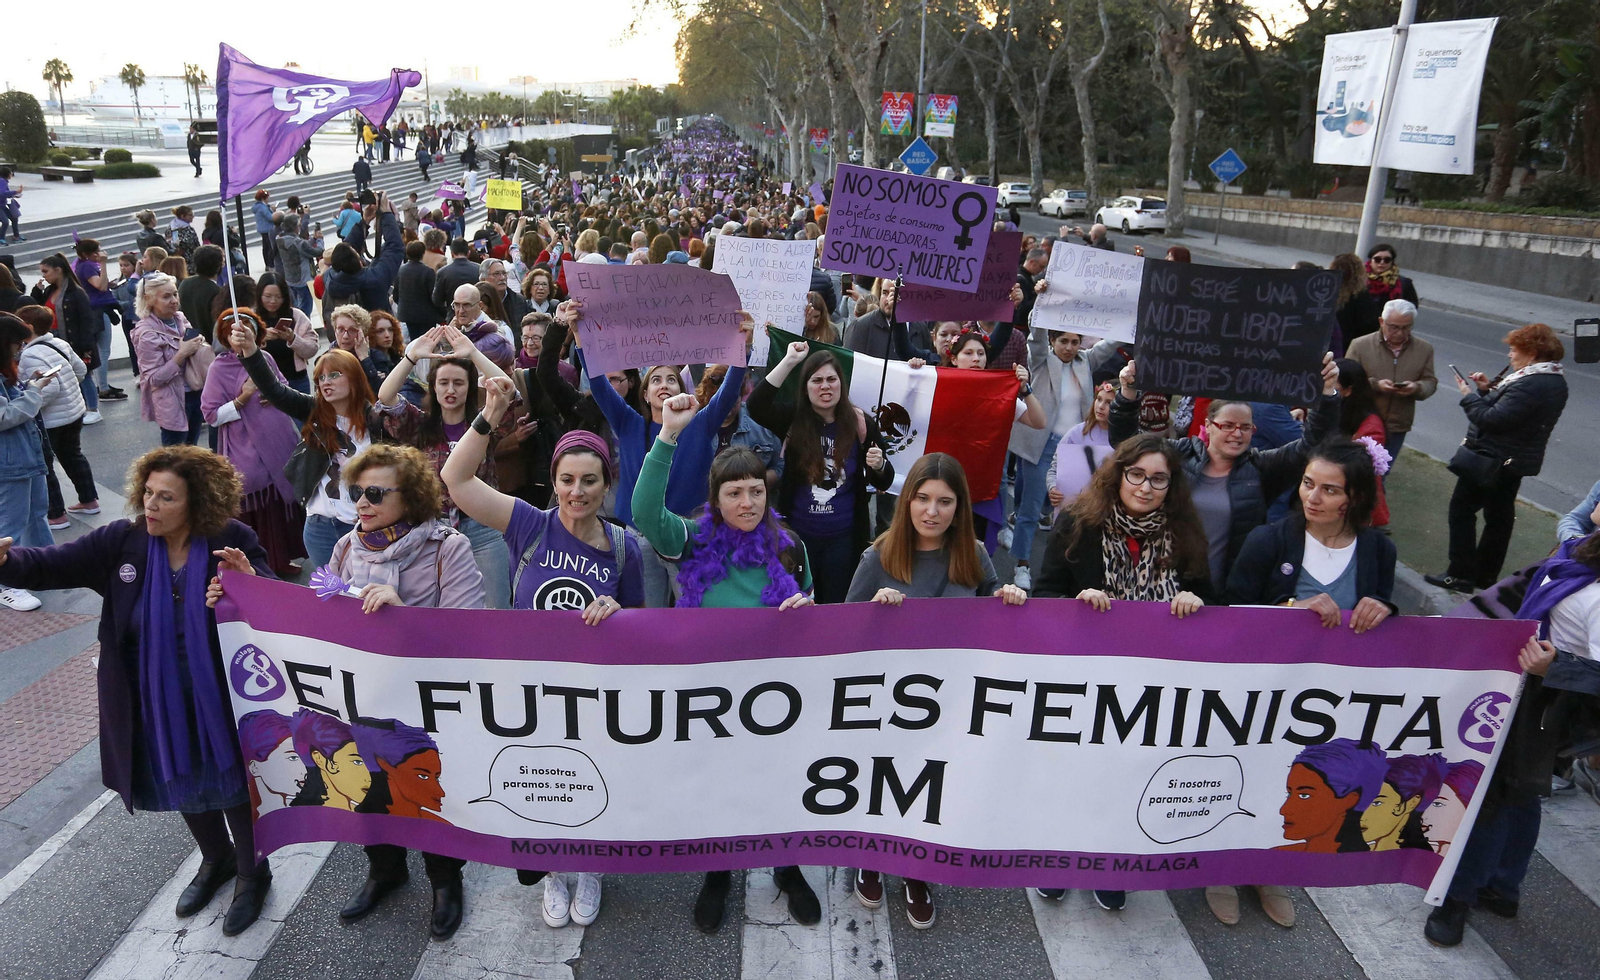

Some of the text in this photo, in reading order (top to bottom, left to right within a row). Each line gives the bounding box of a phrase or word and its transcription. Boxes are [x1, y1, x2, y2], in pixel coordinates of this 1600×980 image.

[1425, 49, 1462, 58] queremos
[1402, 123, 1428, 134] hay que
[842, 171, 950, 209] NO SOMOS
[836, 201, 945, 232] objetos de consumo
[720, 238, 813, 257] EXIGIMOS ALTO
[831, 224, 938, 253] ni INCUBADORAS,
[718, 253, 807, 270] A LA VIOLENCIA
[826, 241, 978, 285] SOMOS MUJERES
[736, 270, 754, 280] LA
[761, 270, 806, 282] MUJER
[1083, 279, 1098, 295] X
[1150, 267, 1298, 307] NO SERÉ UNA
[600, 301, 629, 314] UNA
[636, 293, 694, 310] FORMA
[701, 291, 720, 308] DE
[625, 312, 740, 330] INDIVIDUALMENTE
[1143, 300, 1303, 347] MUJER LIBRE
[586, 340, 593, 355] Y
[598, 338, 615, 353] DE
[1140, 333, 1283, 362] MIENTRAS HAYA
[1139, 355, 1317, 403] MUJERES OPRIMIDAS
[539, 549, 611, 584] JUNTAS
[282, 659, 396, 731] EL
[415, 681, 803, 745] FUTURO
[828, 672, 945, 731] ES
[967, 675, 1445, 751] FEMINISTA
[1480, 712, 1501, 730] marzo
[519, 765, 577, 778] Si nosotras
[569, 783, 594, 791] para
[801, 756, 949, 827] 8M
[1167, 779, 1222, 789] Si nosotras
[525, 793, 574, 803] el mundo
[1197, 795, 1208, 803] se
[1209, 793, 1233, 804] para
[1166, 807, 1210, 818] el mundo
[511, 834, 1201, 872] MOVIMIENTO FEMINISTA Y ASOCIATIVO DE MUJERES DE MÁLAGA
